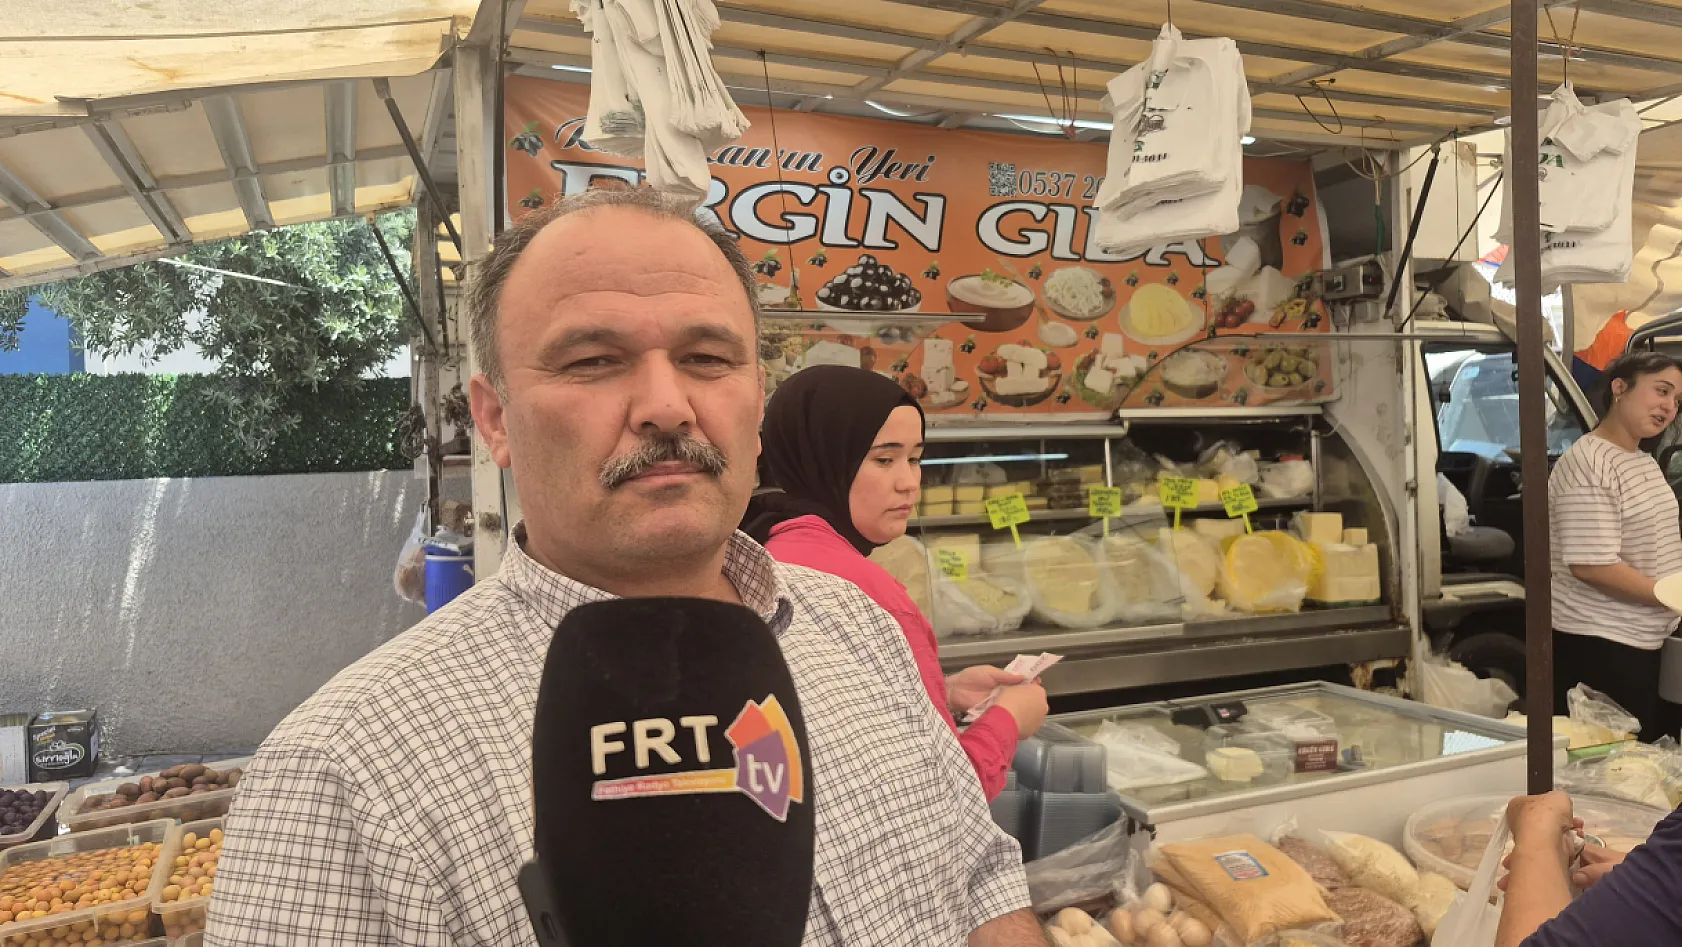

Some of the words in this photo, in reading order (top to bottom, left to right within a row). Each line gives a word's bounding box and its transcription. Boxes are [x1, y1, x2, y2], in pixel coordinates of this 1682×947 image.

[850, 145, 936, 185] Yeri
[1018, 169, 1077, 199] 0537
[591, 714, 719, 775] FRT
[746, 753, 785, 795] tv
